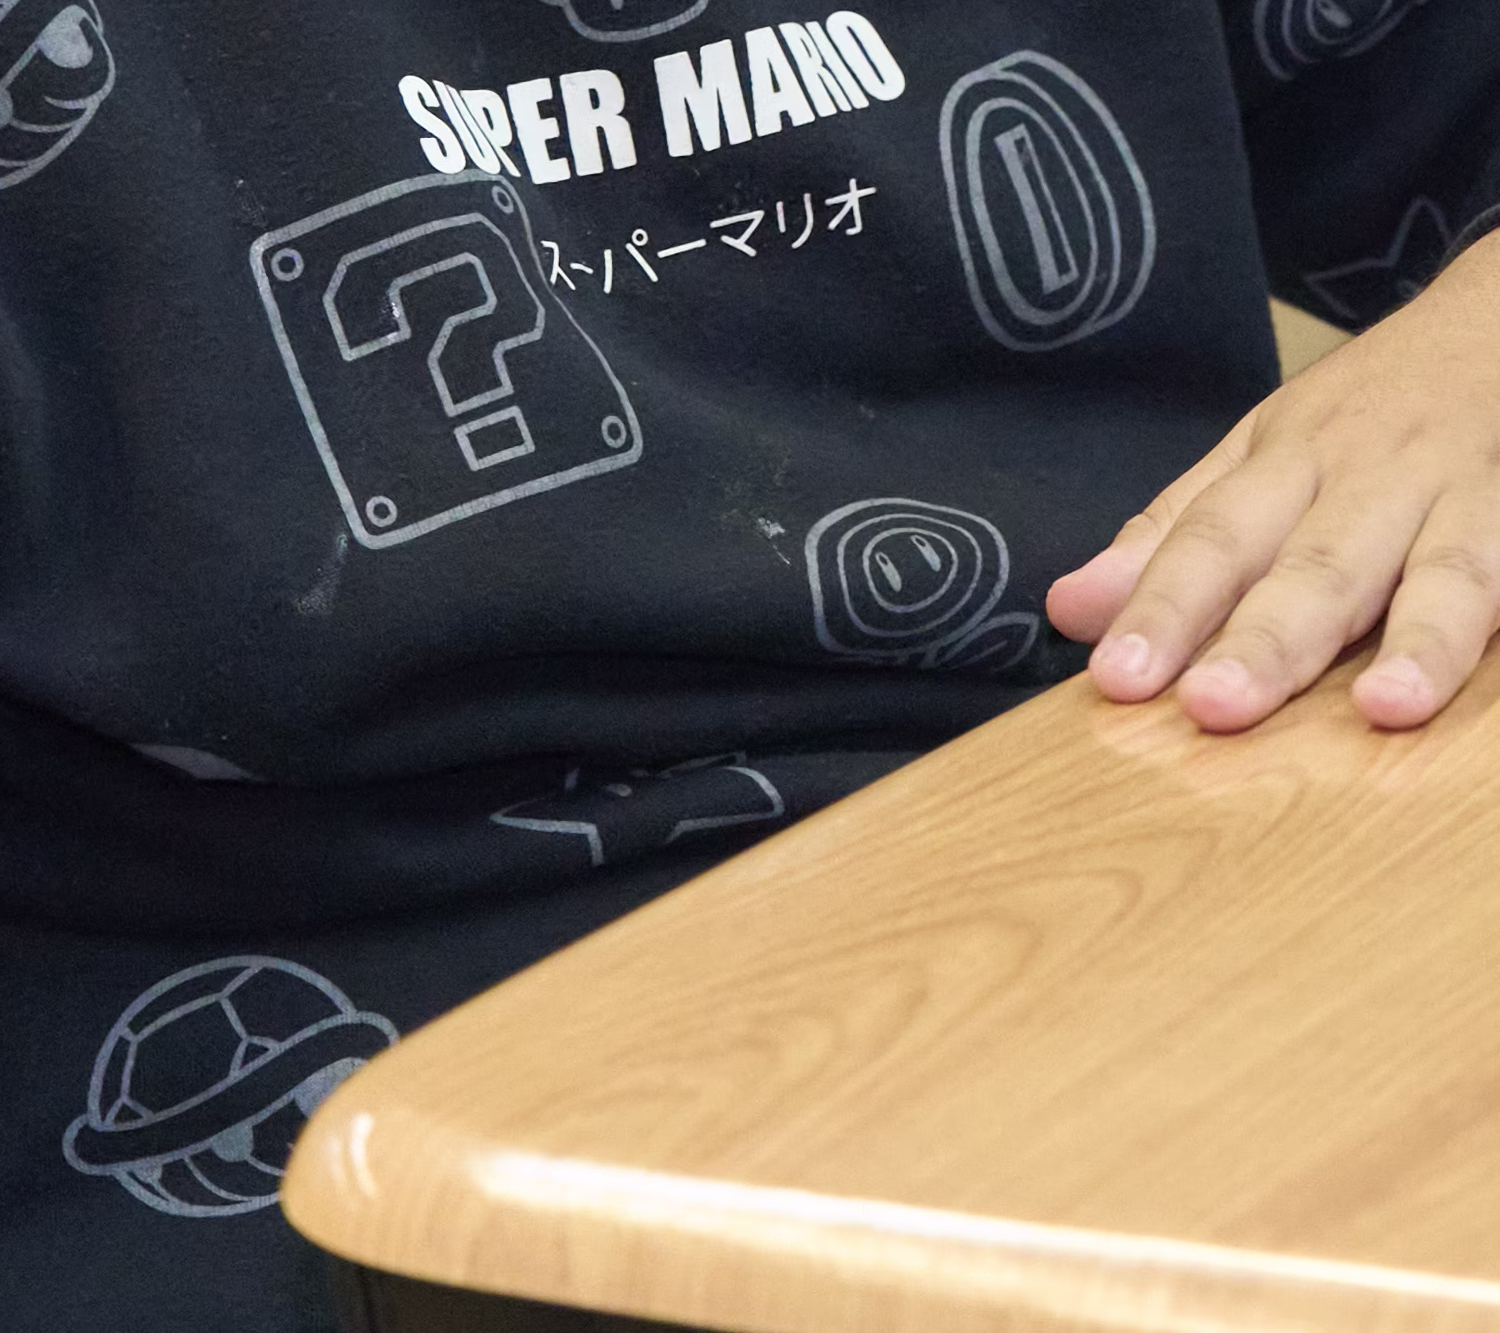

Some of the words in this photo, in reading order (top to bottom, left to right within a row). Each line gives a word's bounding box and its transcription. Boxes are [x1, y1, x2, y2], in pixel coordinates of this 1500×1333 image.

[398, 69, 637, 184] SUPER
[653, 11, 906, 158] MARIO
[540, 178, 878, 293] スーパーマリオ
